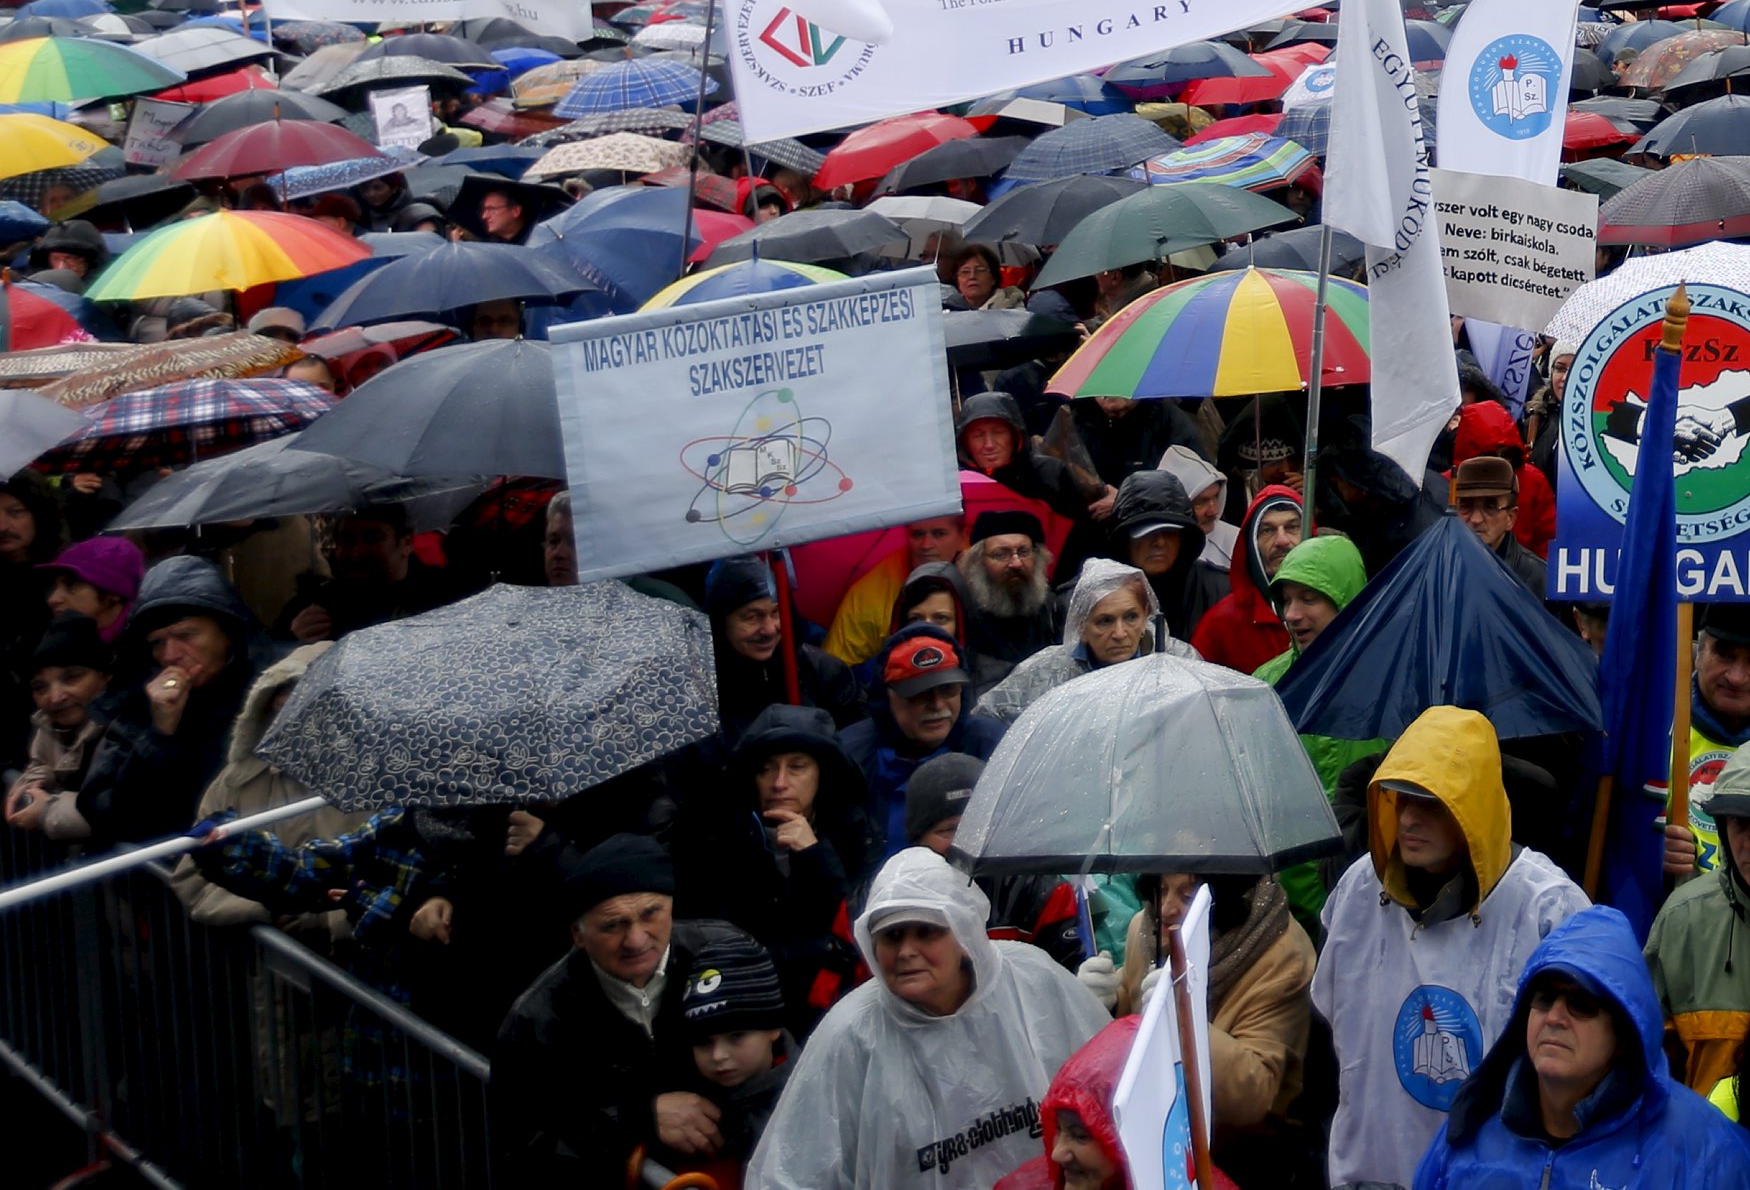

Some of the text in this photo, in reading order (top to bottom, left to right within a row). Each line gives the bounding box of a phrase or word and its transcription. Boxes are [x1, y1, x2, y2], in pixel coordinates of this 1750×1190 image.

[798, 81, 837, 98] SZEF
[1445, 222, 1560, 256] Neve: birkaiskola.
[1469, 204, 1499, 218] volt
[1501, 209, 1525, 226] egy
[1526, 214, 1554, 232] nagy
[1556, 222, 1597, 241] csoda,
[1440, 247, 1589, 284] em szólt, csak bégetett,
[1450, 266, 1498, 284] kapott
[582, 283, 915, 372] MAGYAR KÖZOKTATÁSI ÉS SZAKKÉPZÉSI
[689, 343, 825, 396] SZAKSZERVEZET
